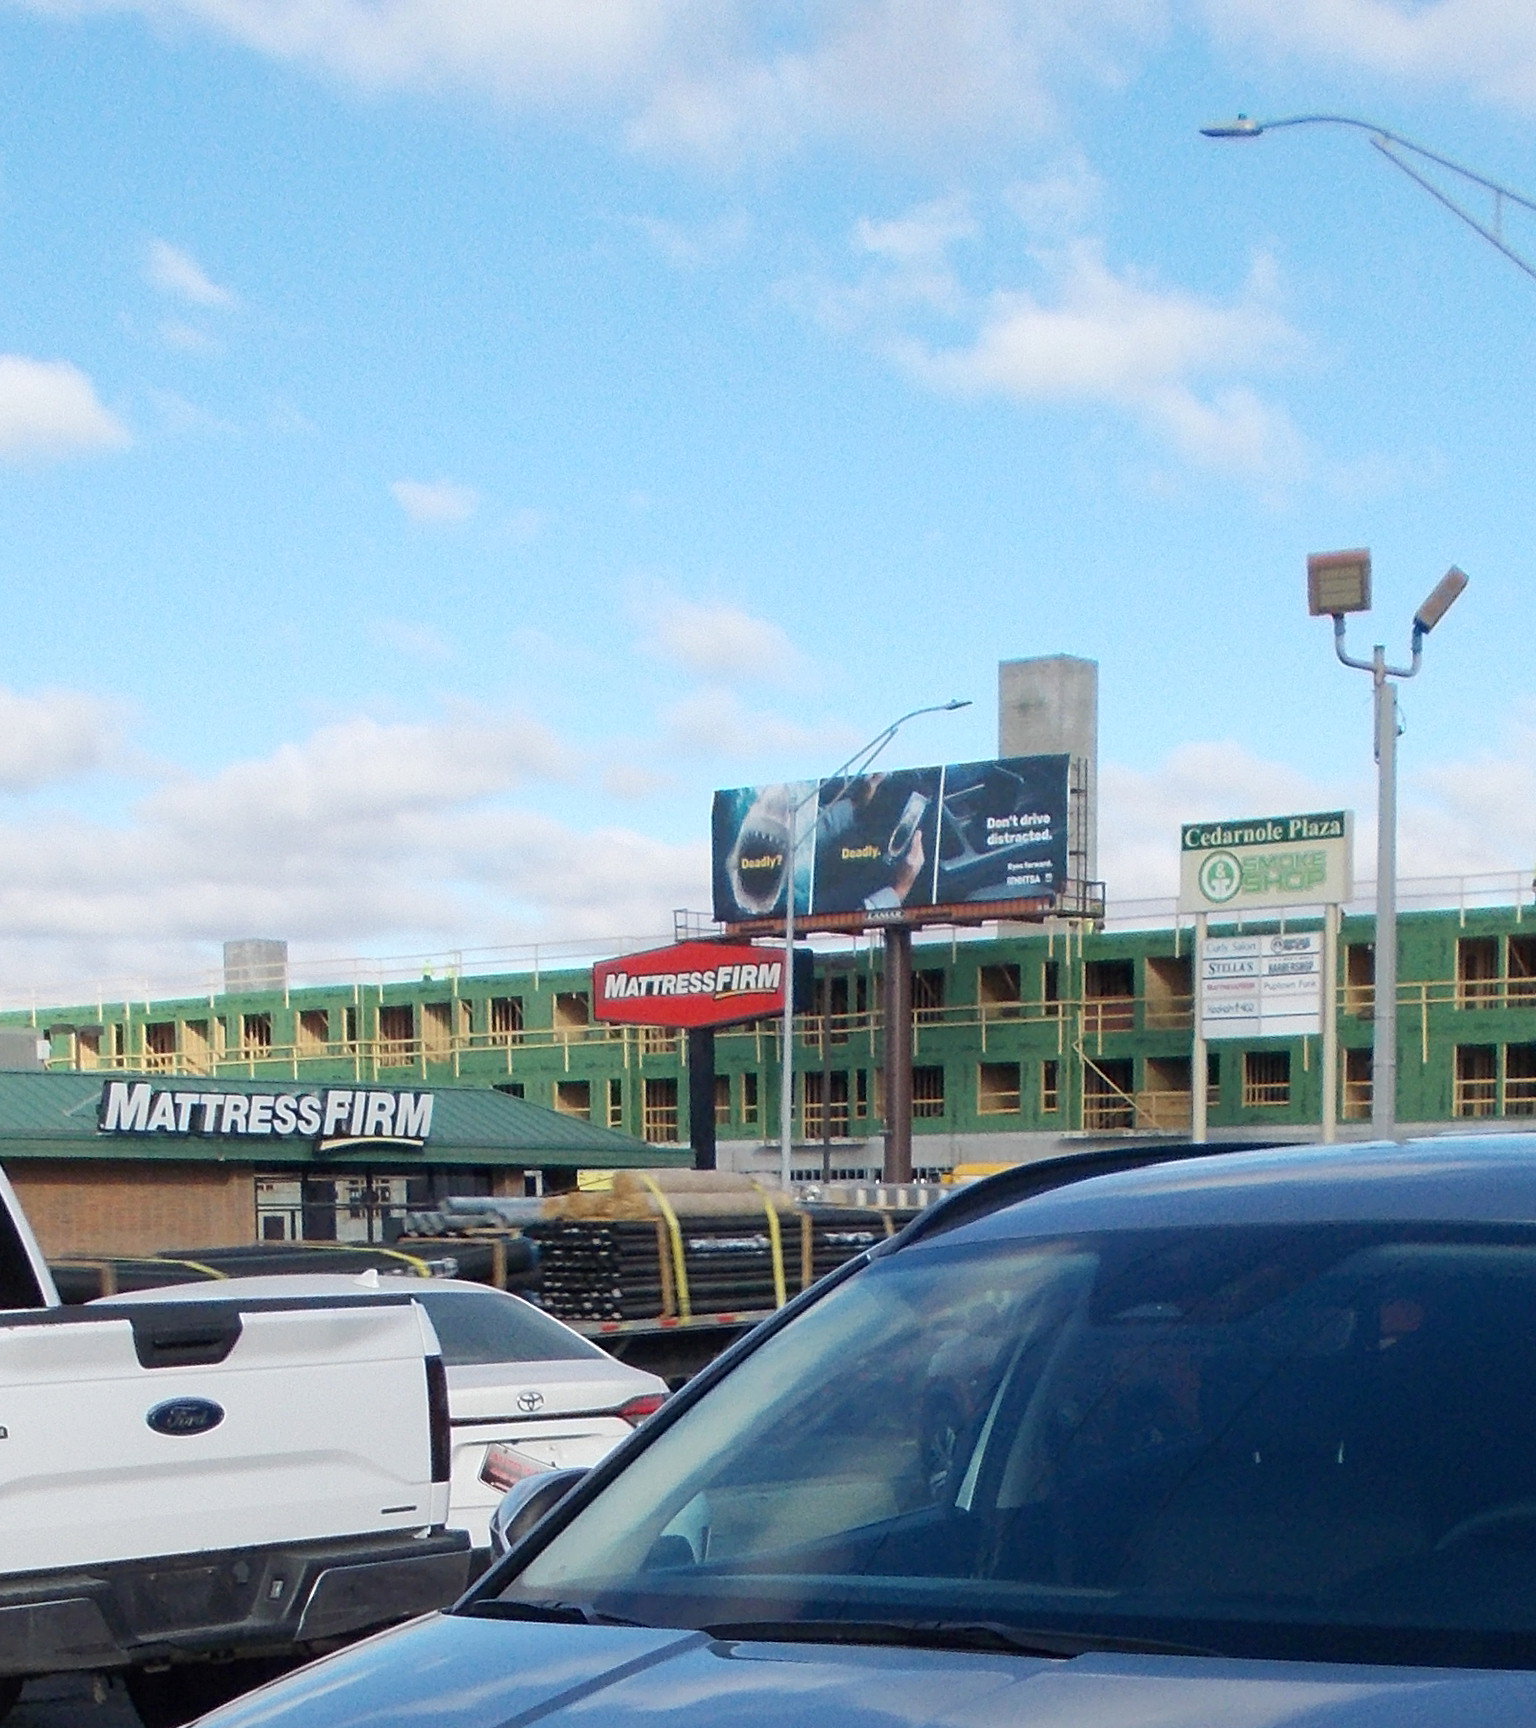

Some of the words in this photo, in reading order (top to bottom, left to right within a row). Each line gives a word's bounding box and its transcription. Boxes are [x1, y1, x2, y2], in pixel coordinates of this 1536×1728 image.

[987, 815, 1019, 829] Don't
[1020, 812, 1051, 826] drive
[987, 828, 1053, 845] distracted.
[1184, 821, 1283, 847] Cedarnole
[1289, 818, 1341, 839] Plaza
[741, 854, 782, 870] Deadly?
[842, 845, 881, 859] Deadly.
[1241, 868, 1327, 894] SHOP
[604, 962, 782, 999] MATTRESSFIRM
[105, 1081, 435, 1138] MATTRESSFIRM
